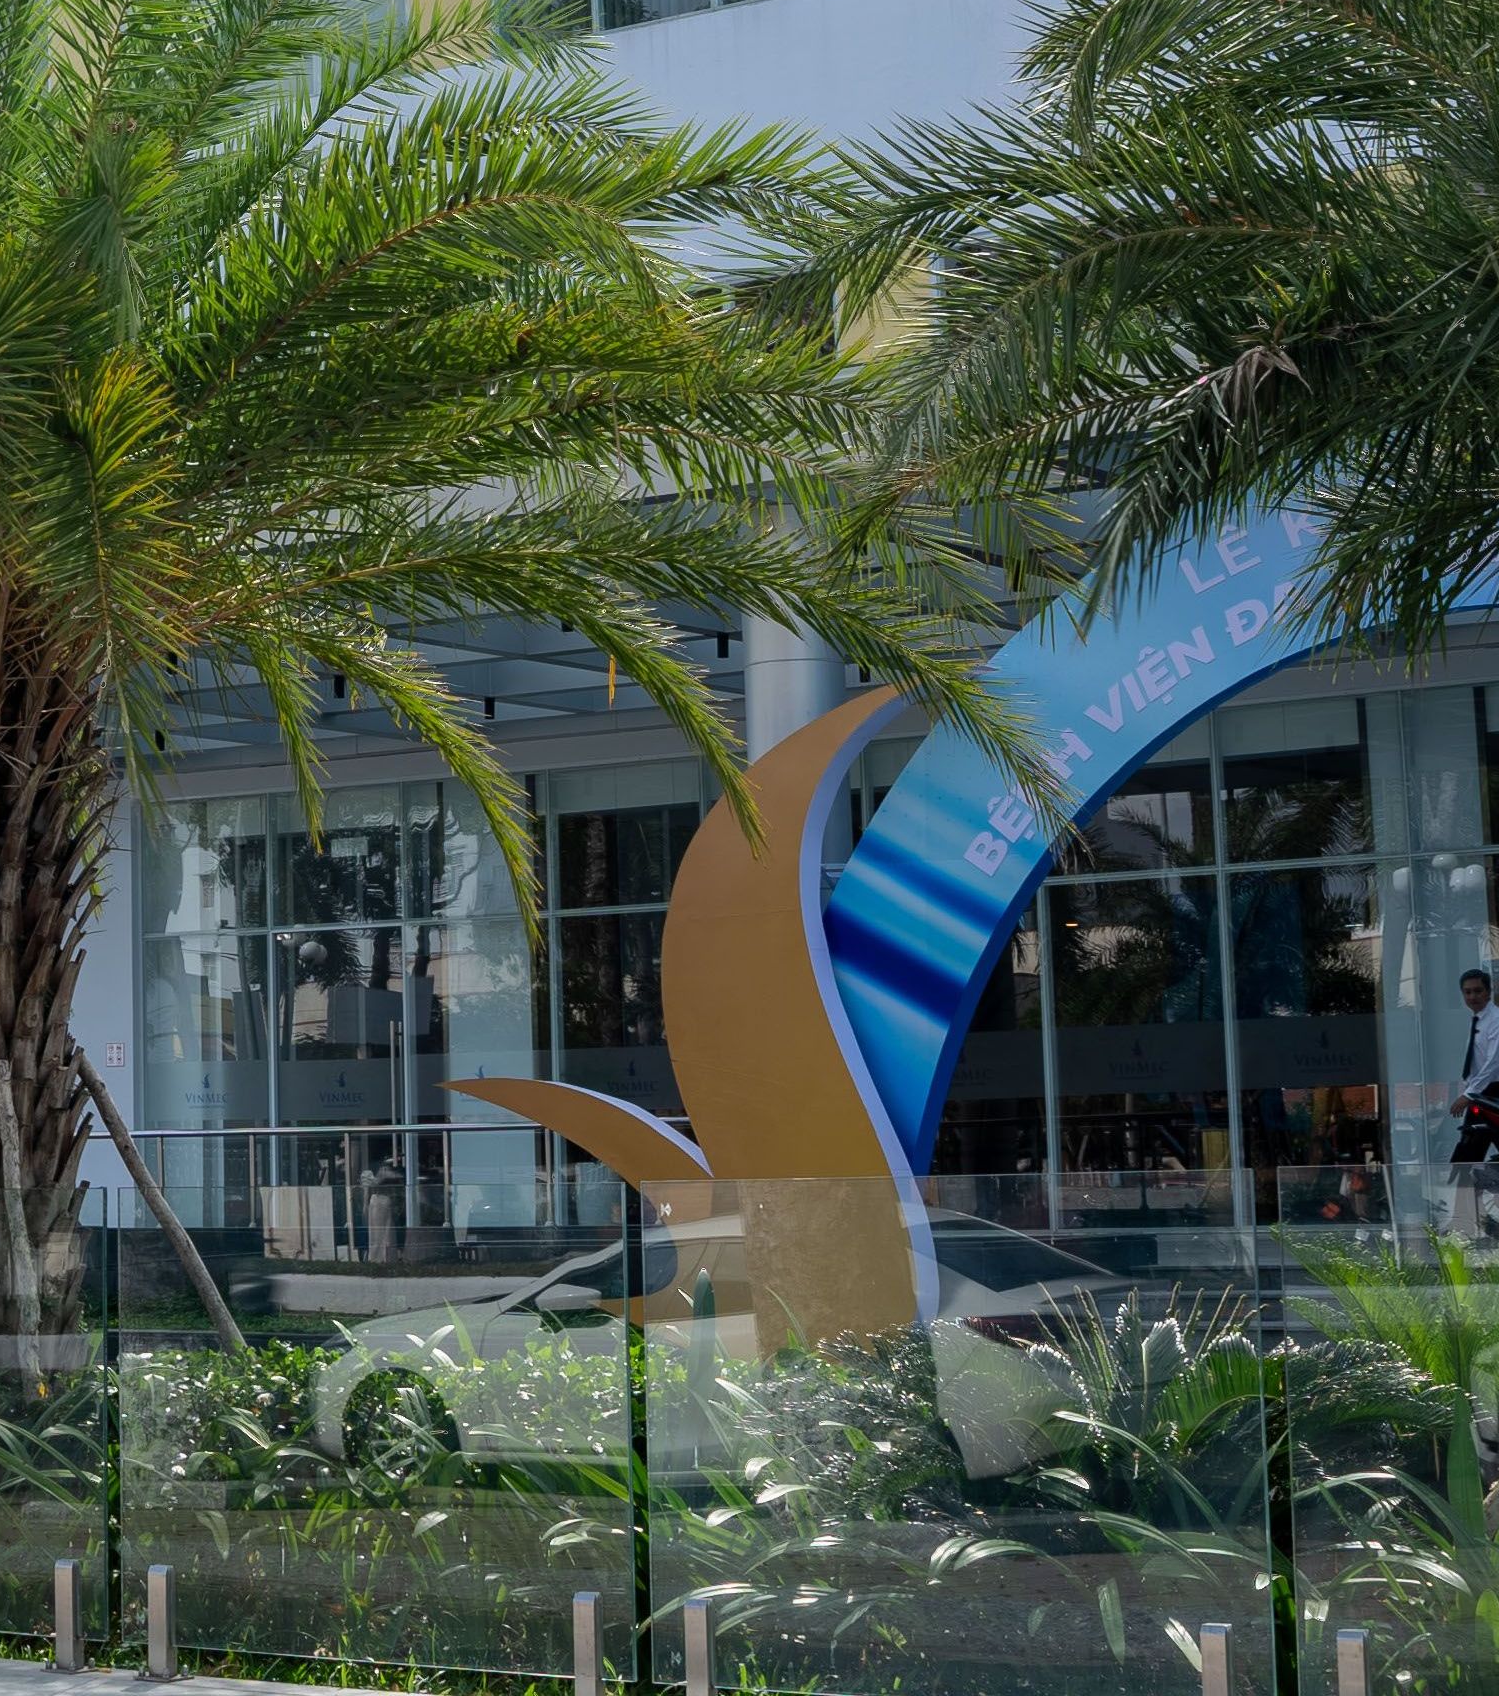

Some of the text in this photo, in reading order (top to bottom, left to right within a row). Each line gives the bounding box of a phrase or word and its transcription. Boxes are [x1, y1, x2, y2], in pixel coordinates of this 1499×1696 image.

[1084, 625, 1218, 734] VIỆN
[185, 1092, 228, 1104] VINMEC
[319, 1092, 365, 1104] VINMEC
